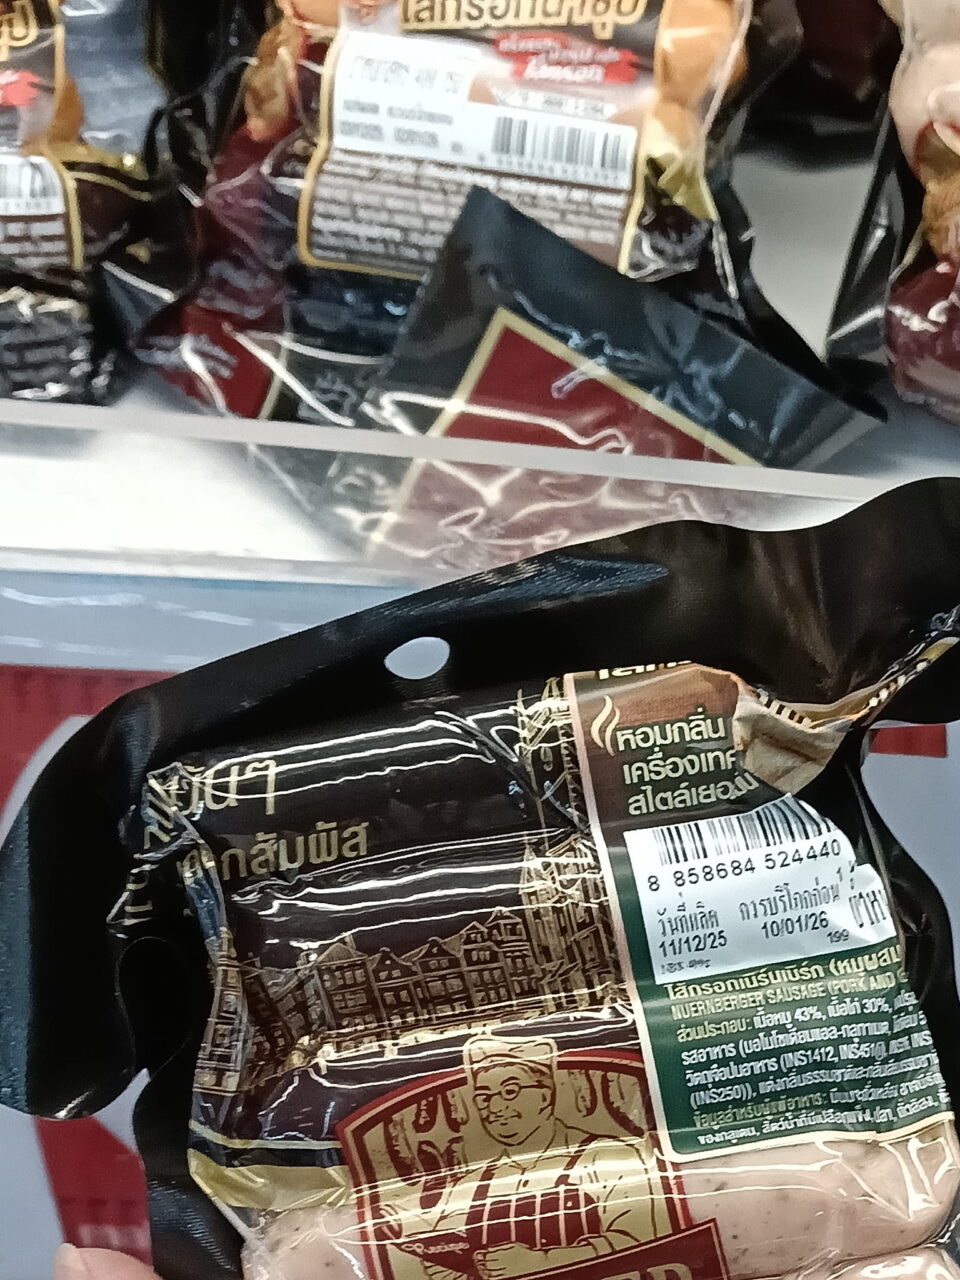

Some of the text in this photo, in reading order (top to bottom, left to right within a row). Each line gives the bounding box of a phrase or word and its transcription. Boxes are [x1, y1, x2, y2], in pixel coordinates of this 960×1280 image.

[616, 707, 726, 751] หอมกลิ่น
[647, 838, 841, 892] 8 858684 524440
[659, 911, 829, 958] 11/12/25 10/01/26
[671, 991, 766, 1020] NUERNBERGER
[766, 982, 827, 1005] SAUSAGE
